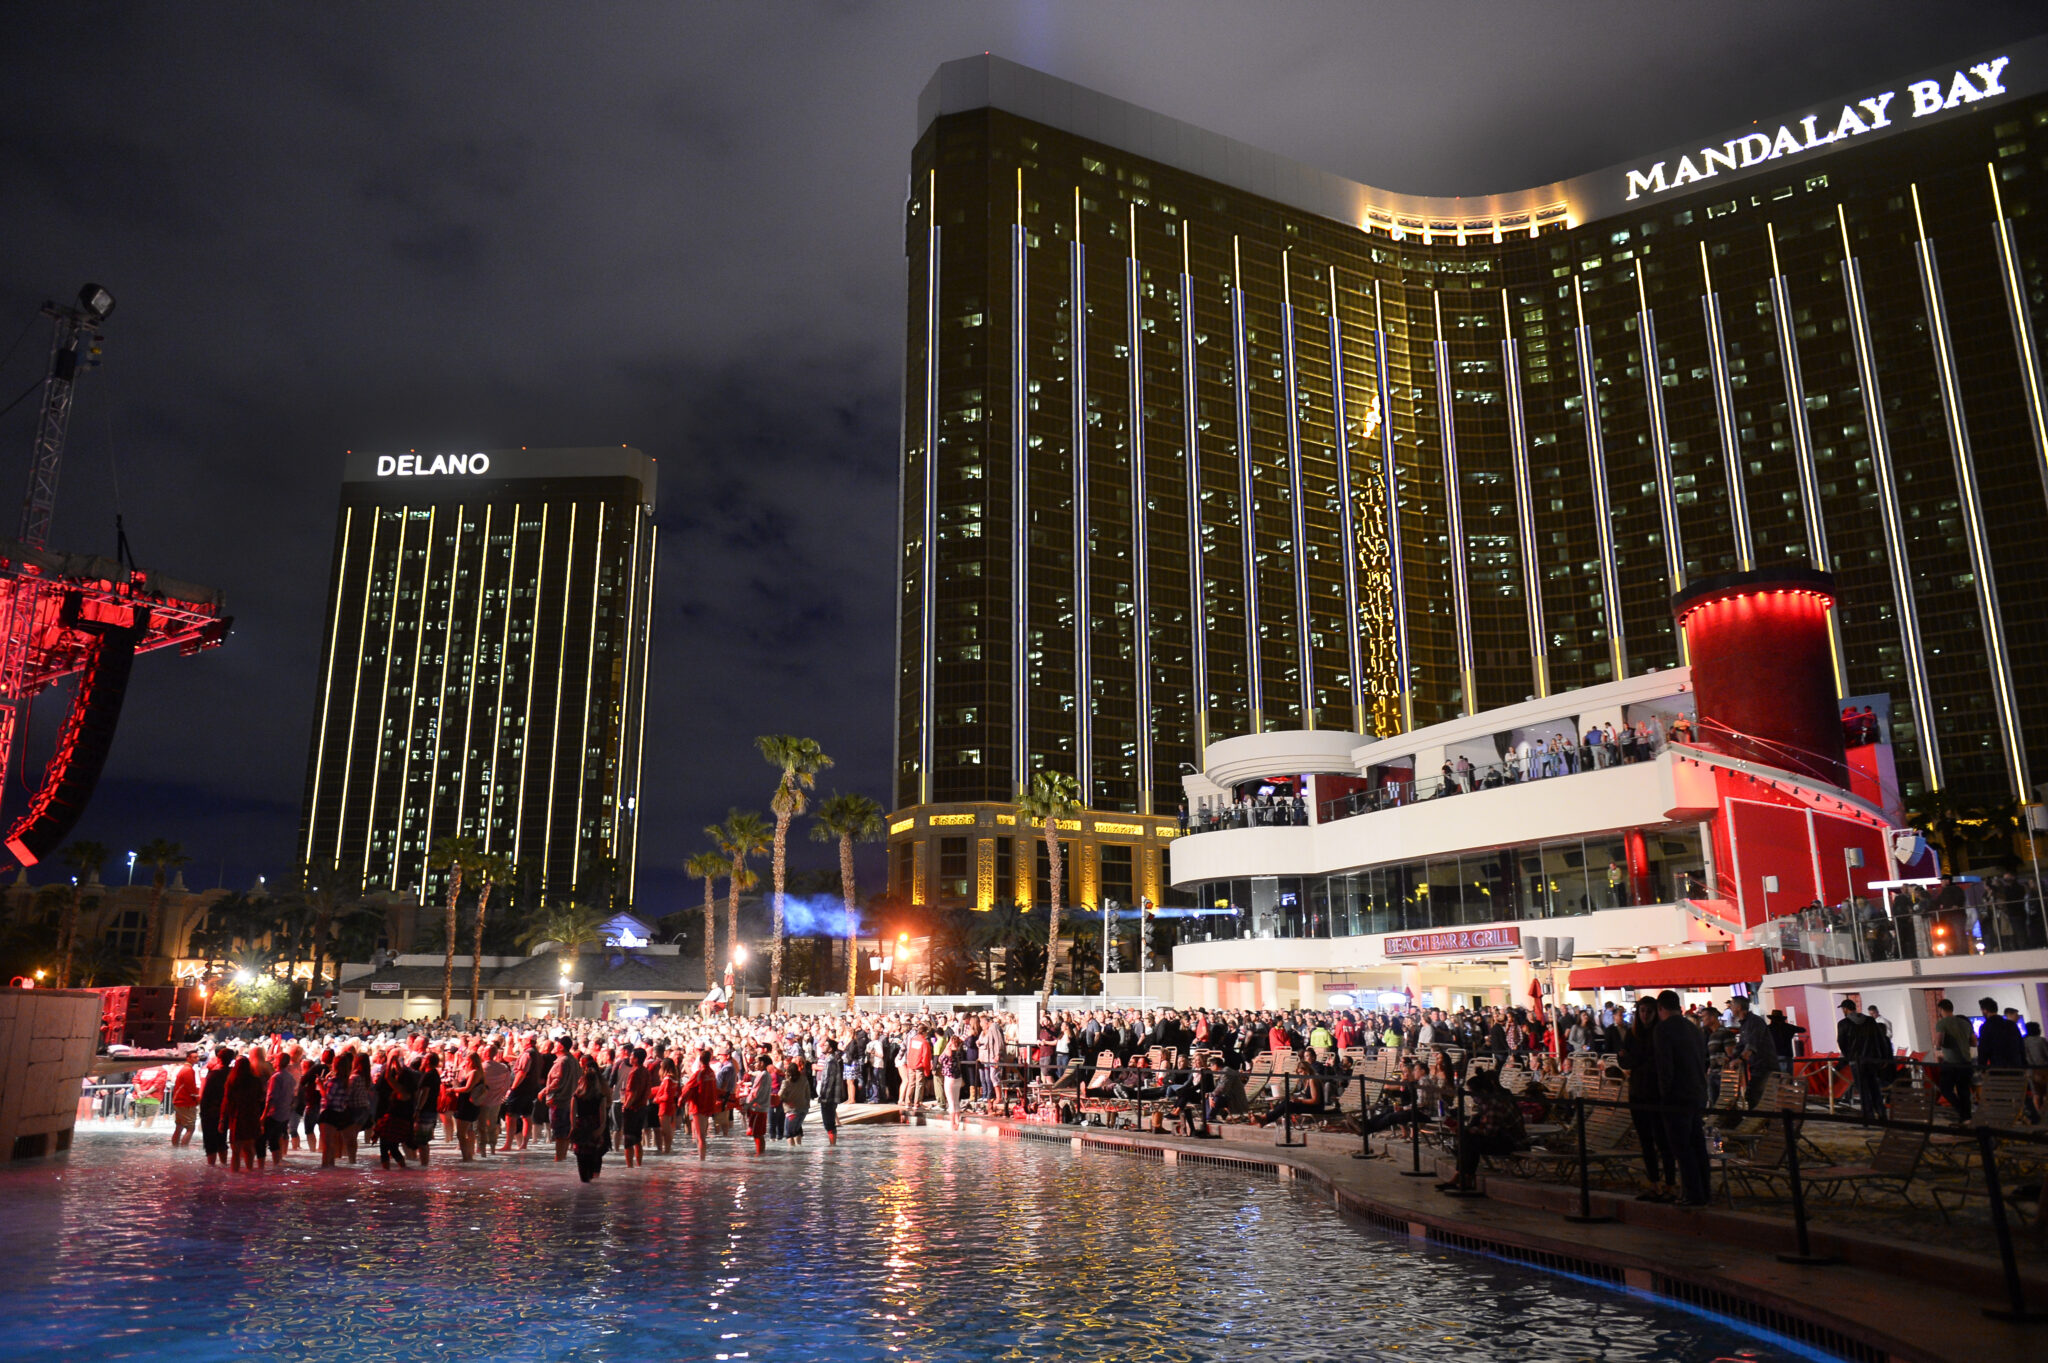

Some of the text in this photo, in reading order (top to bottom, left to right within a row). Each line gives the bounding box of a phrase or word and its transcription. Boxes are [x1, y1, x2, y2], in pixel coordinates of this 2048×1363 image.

[1625, 56, 2010, 201] MANDALAY BAY
[377, 453, 490, 476] DELANO
[1386, 929, 1513, 954] BEACH BAR & GRILL
